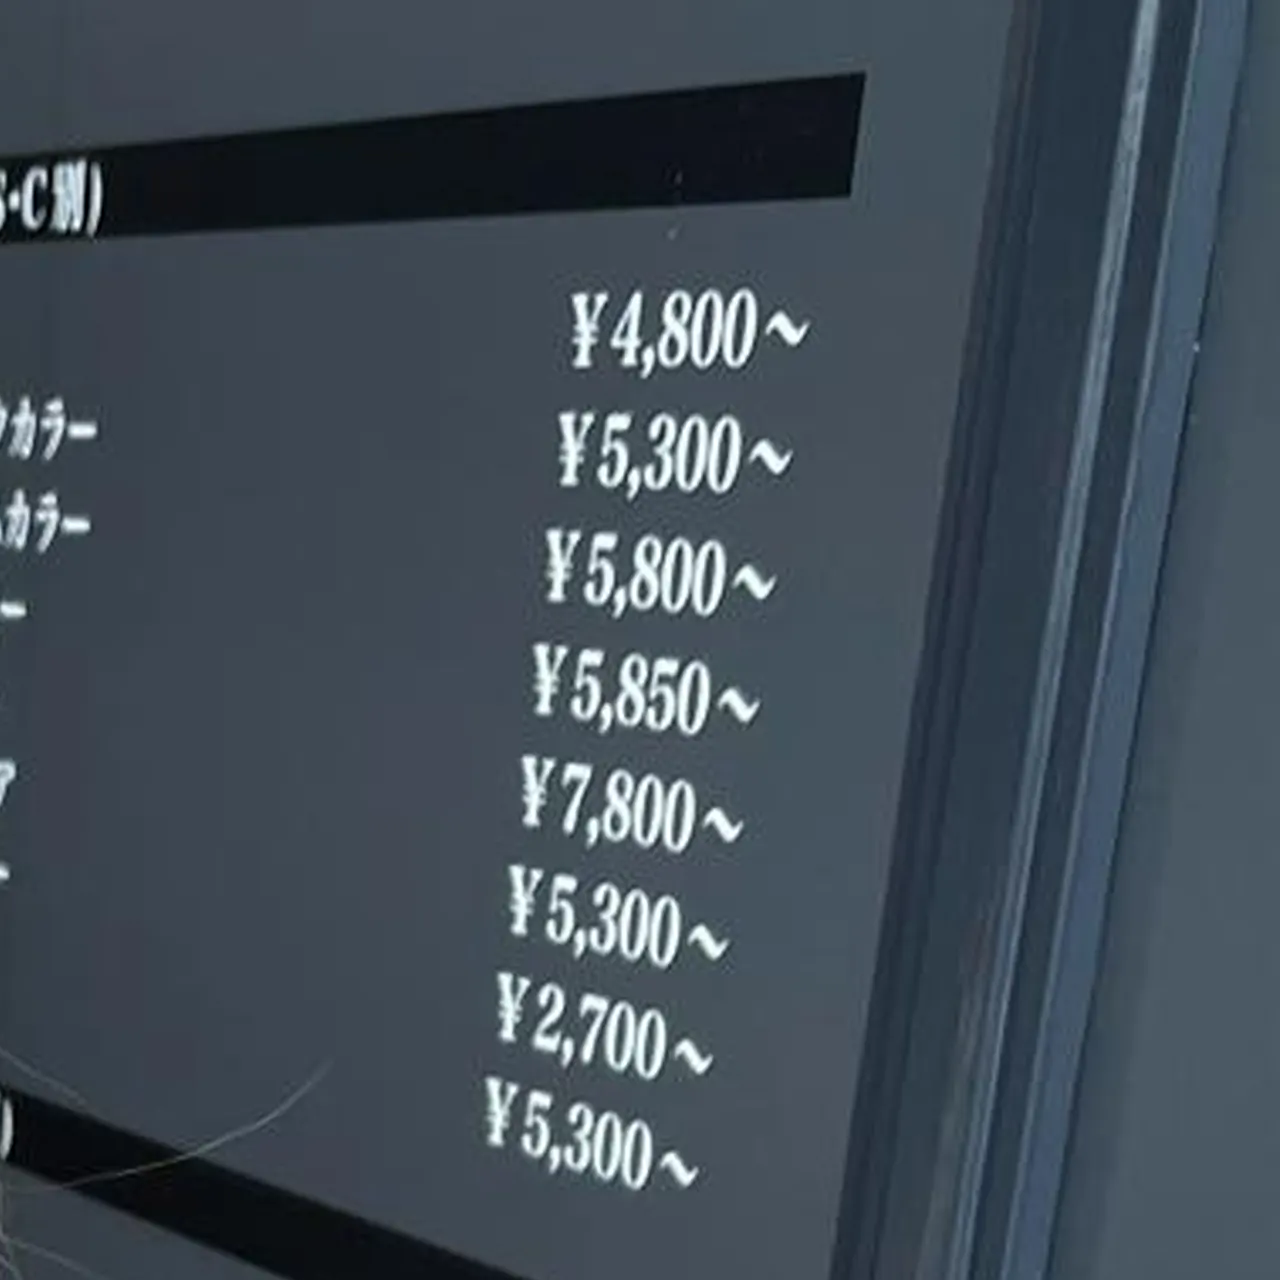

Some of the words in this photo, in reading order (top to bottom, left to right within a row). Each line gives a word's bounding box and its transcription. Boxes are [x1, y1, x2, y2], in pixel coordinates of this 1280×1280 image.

[571, 287, 810, 379] ¥4,800~
[558, 410, 793, 501] ¥5,300~
[545, 527, 777, 619] ¥5,800~
[532, 641, 761, 736] ¥5,850~
[521, 753, 744, 854] ¥7,800~
[508, 864, 729, 969] ¥5,300~
[496, 971, 713, 1080] ¥2,700~
[485, 1076, 700, 1191] ¥5,300~
